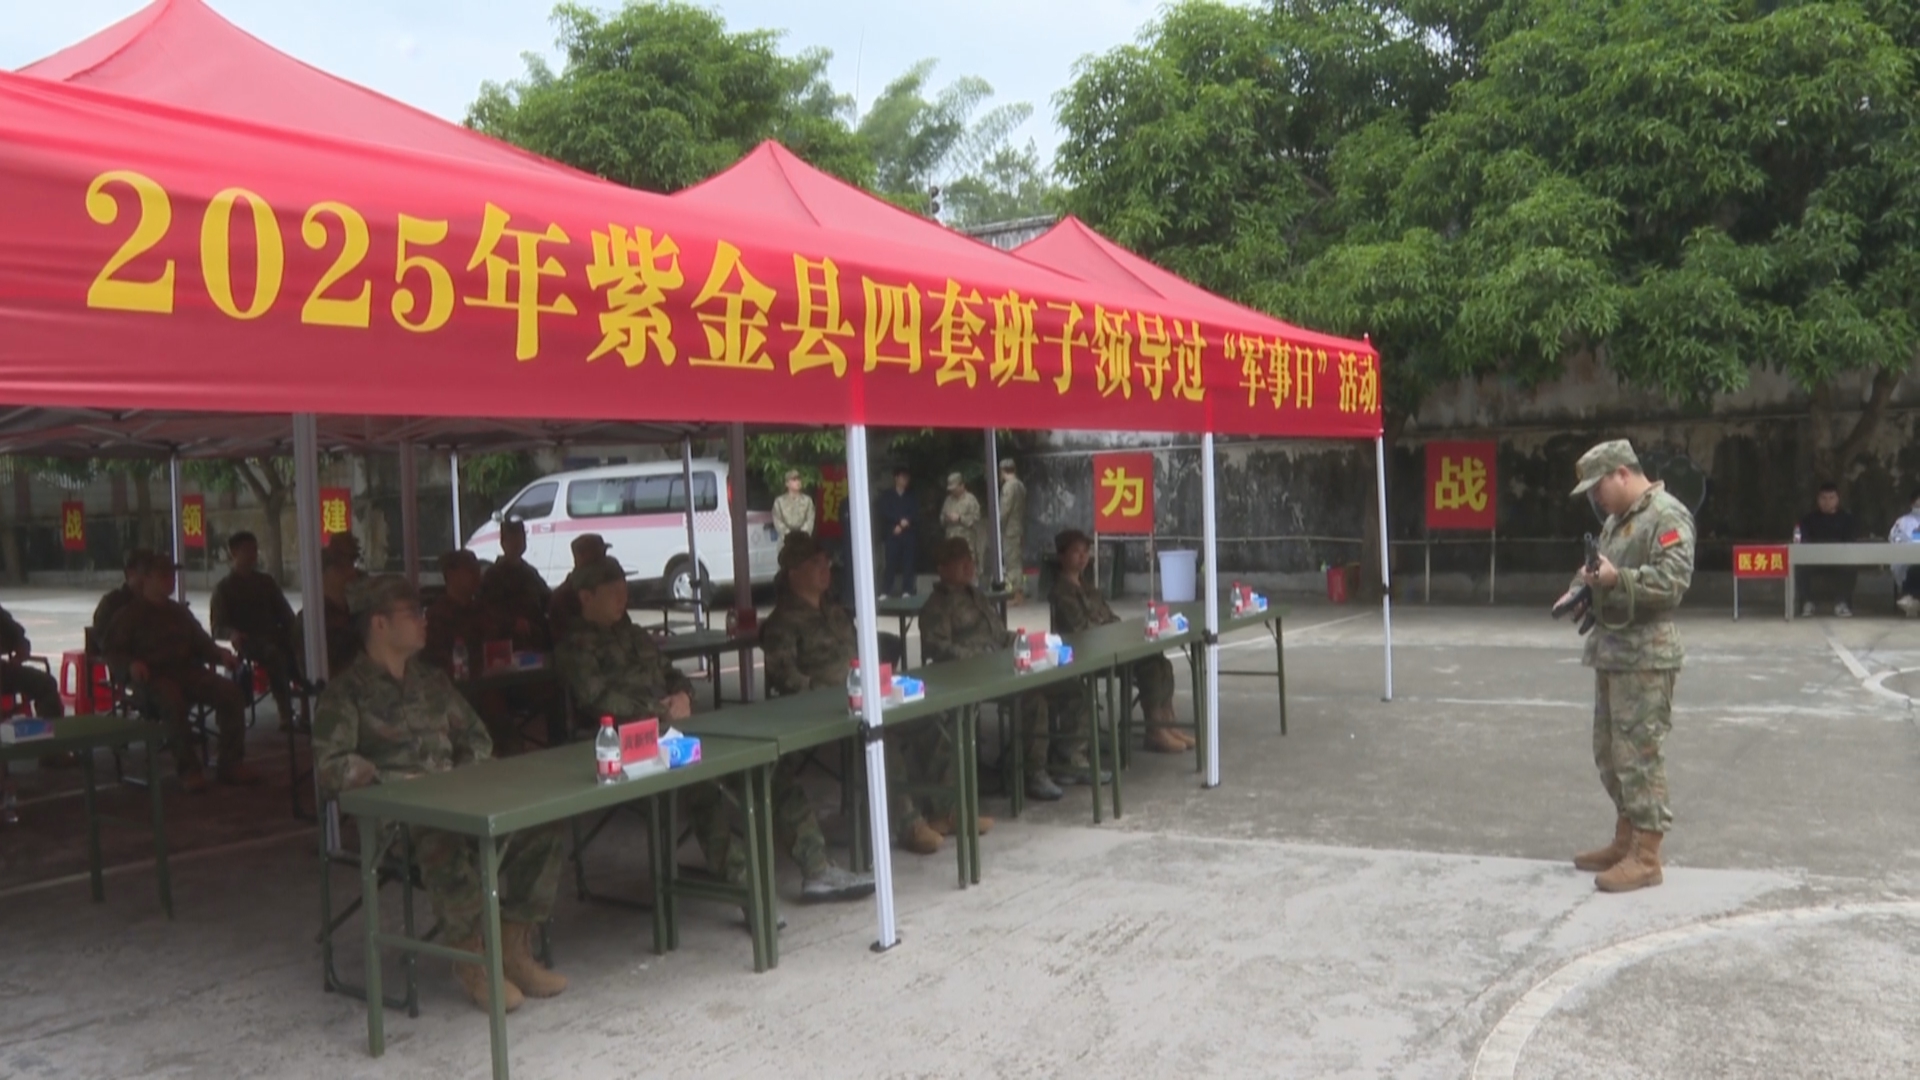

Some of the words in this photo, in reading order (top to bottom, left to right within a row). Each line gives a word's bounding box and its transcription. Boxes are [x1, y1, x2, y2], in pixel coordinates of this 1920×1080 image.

[1101, 467, 1144, 517] 为
[1435, 456, 1488, 511] 战
[65, 509, 82, 541] 战
[182, 503, 202, 536] 领
[322, 497, 348, 534] 建
[1738, 553, 1783, 571] 医务员
